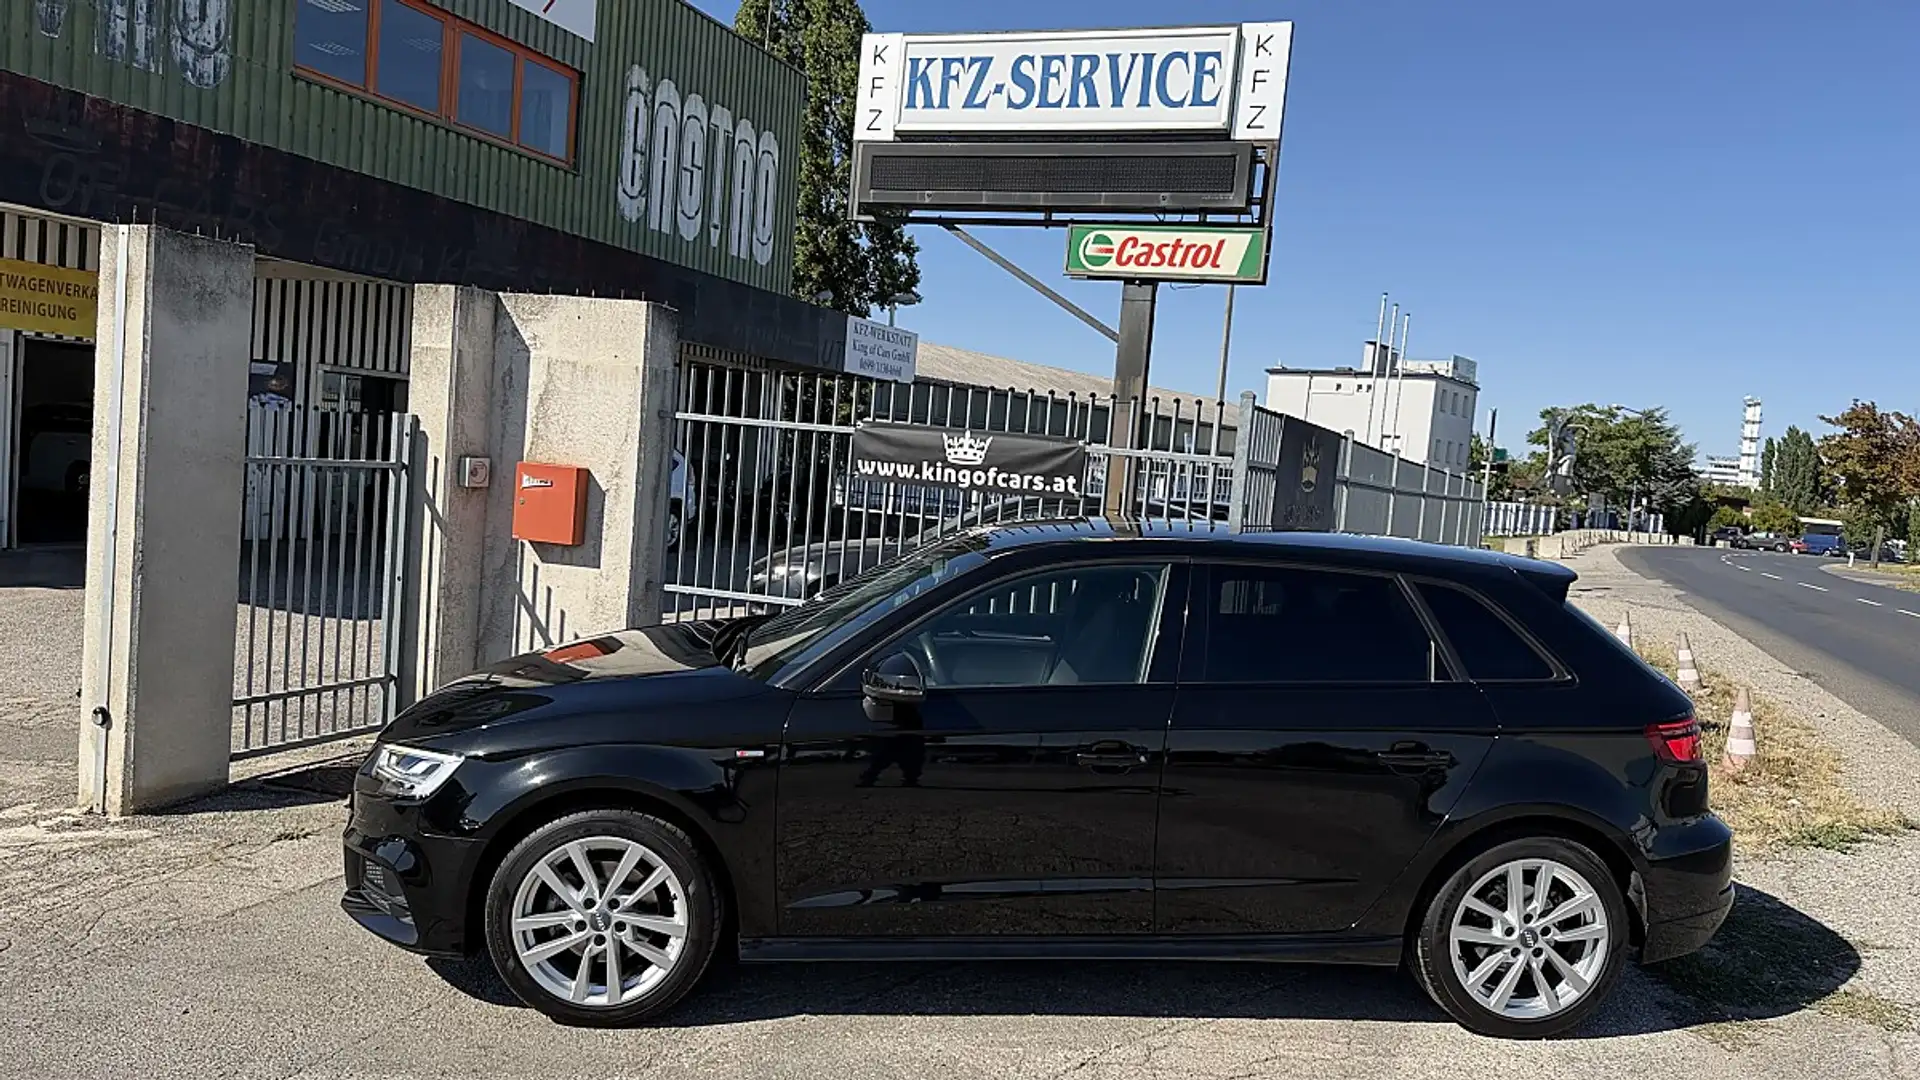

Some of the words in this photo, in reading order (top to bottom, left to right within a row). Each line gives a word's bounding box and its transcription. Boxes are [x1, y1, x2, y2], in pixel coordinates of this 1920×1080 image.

[866, 43, 889, 132] KFZ
[904, 51, 1223, 110] KFZ-SERVICE
[1246, 33, 1276, 130] KFZ
[1115, 235, 1226, 270] Castrol
[857, 459, 1078, 494] www.kingofcars.at
